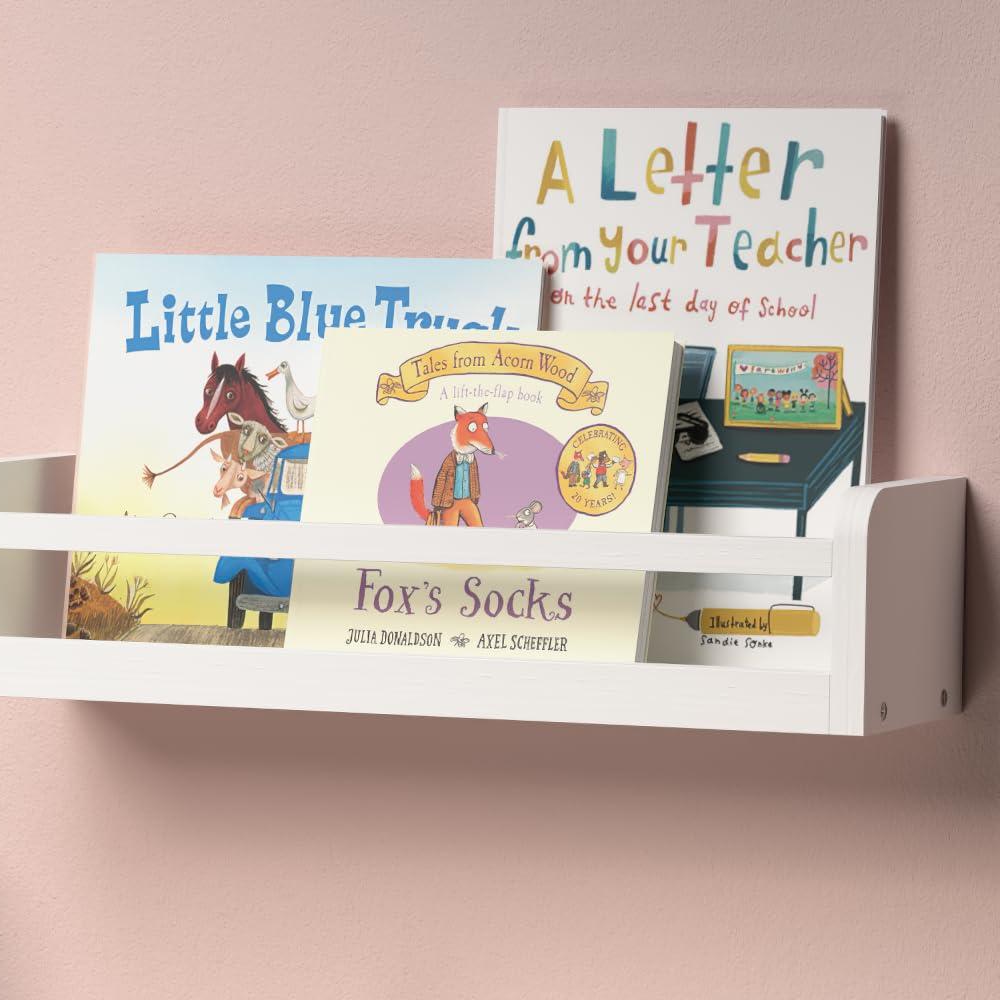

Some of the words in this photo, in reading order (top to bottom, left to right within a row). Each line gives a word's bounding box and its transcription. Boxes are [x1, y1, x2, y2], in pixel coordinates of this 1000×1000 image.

[536, 140, 575, 205] A
[600, 121, 825, 206] Letter
[505, 216, 592, 275] from
[599, 225, 688, 273] your
[694, 207, 869, 271] Teacher
[551, 288, 575, 305] on
[583, 286, 617, 310] the
[629, 282, 672, 312] last
[685, 289, 718, 322] day
[728, 296, 751, 320] of
[125, 288, 252, 354] Little
[265, 283, 366, 344] Blue
[411, 358, 449, 379] Tales
[452, 352, 486, 370] from
[491, 348, 534, 371] Acorn
[538, 351, 579, 384] Wood
[439, 386, 449, 400] A
[452, 383, 515, 402] lift-the-flap
[517, 388, 544, 405] book
[572, 429, 627, 452] CELEBRATING
[571, 491, 582, 503] 20
[584, 491, 617, 508] YEARS!
[460, 576, 573, 622] Socks
[709, 615, 757, 629] Illustrated
[759, 615, 769, 632] by
[345, 628, 378, 646] JULIA
[380, 629, 442, 648] DONALDSON
[477, 633, 507, 651] AXEL
[510, 634, 568, 652] SCHEFFLER
[700, 634, 739, 647] Sandie
